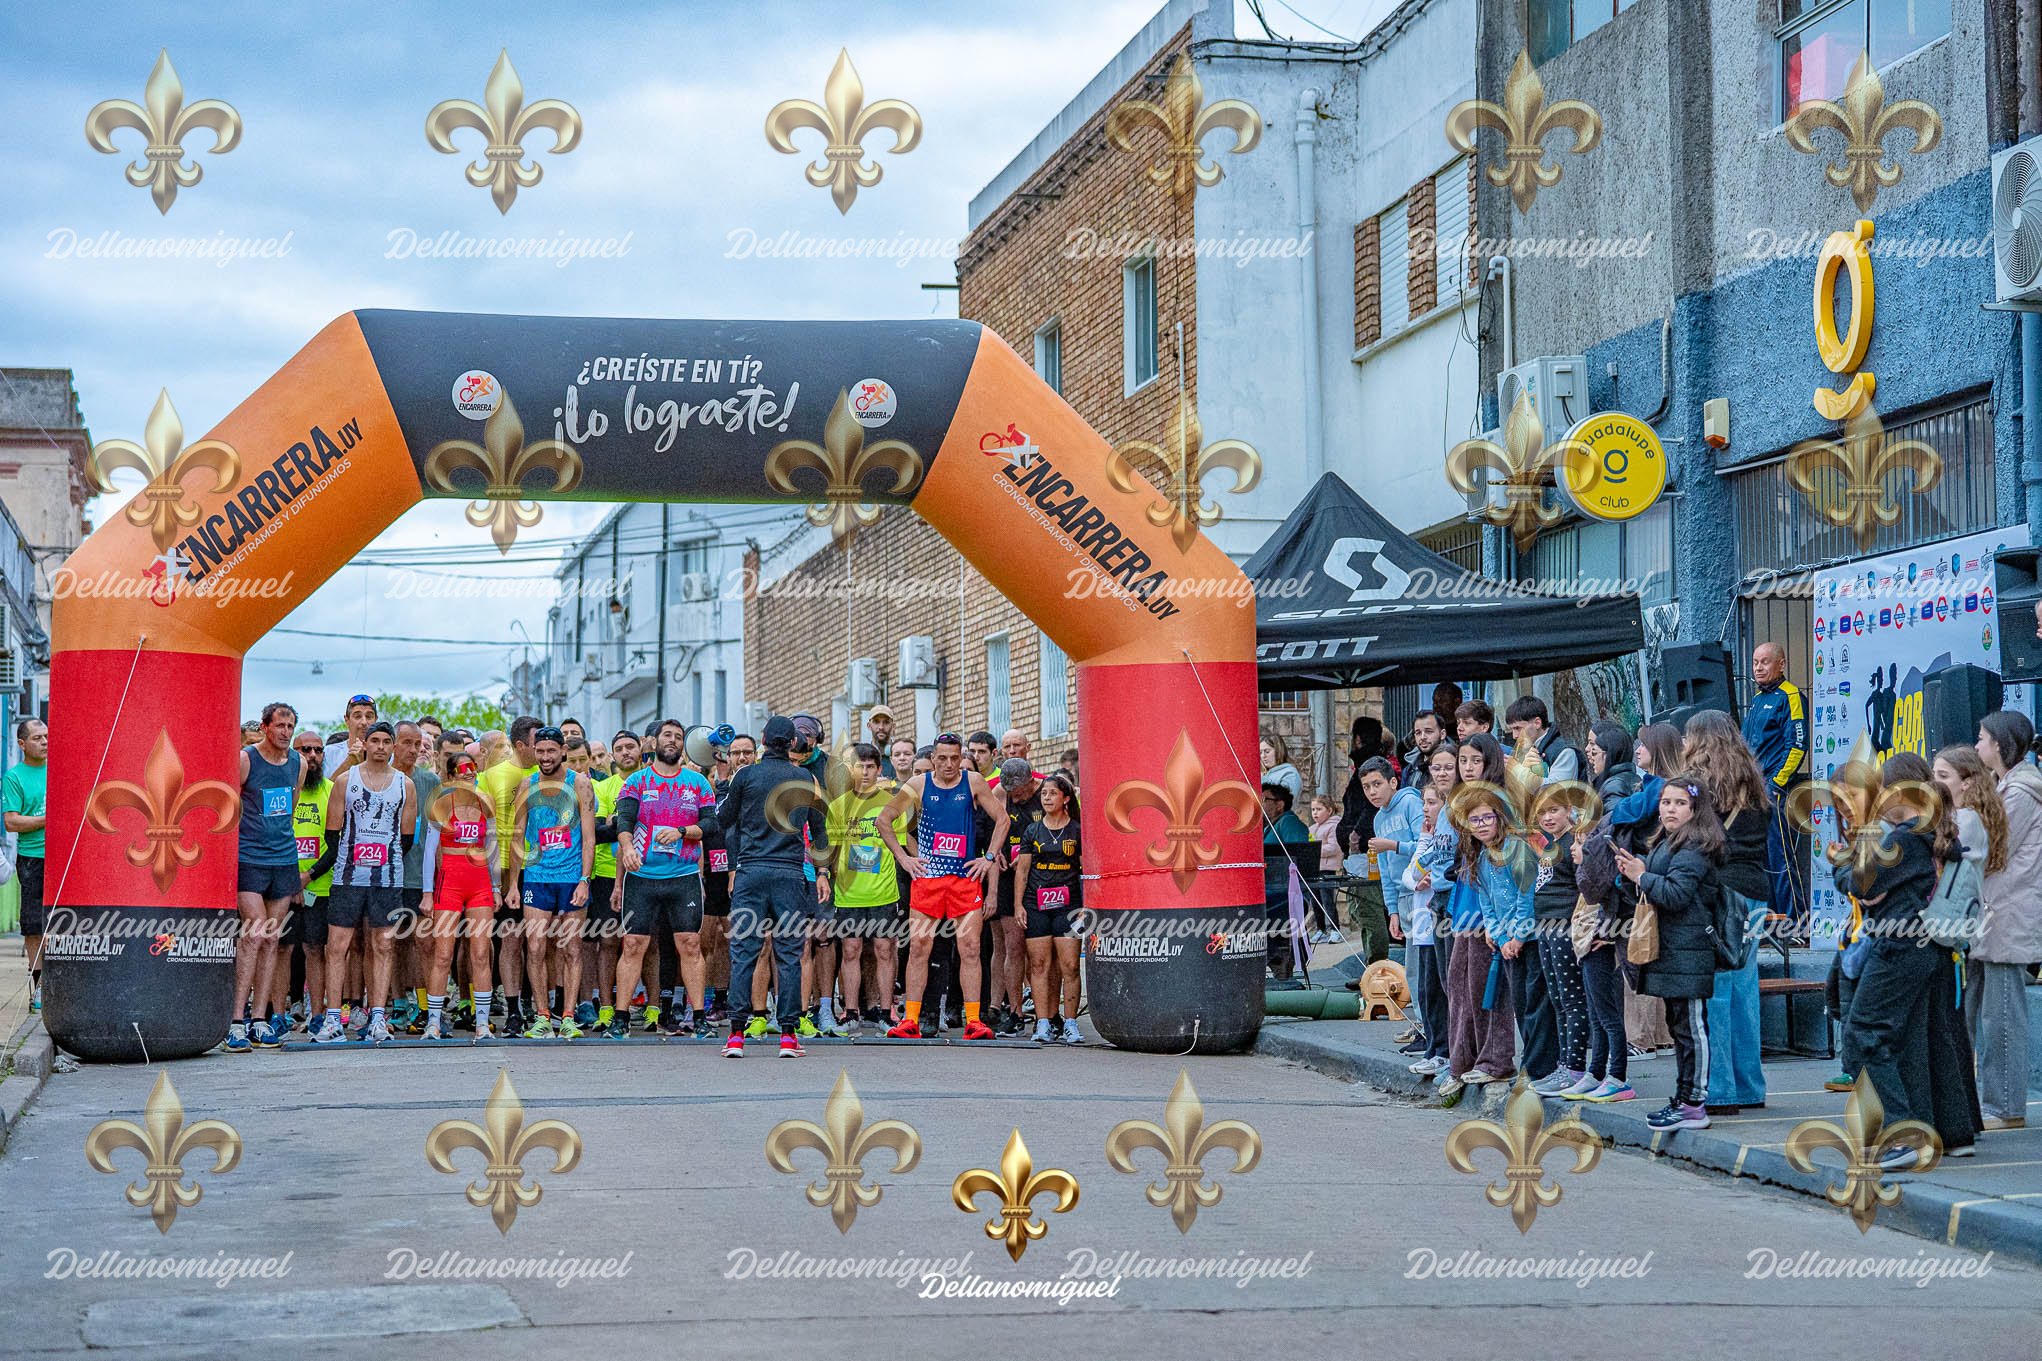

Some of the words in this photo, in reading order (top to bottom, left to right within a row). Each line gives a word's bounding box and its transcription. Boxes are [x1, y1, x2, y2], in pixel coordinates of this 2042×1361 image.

[577, 353, 686, 385] ¿CREÍSTE
[691, 360, 722, 383] EN
[729, 354, 763, 384] TÍ?
[624, 381, 800, 453] lograste!
[1578, 423, 1655, 460] guadalupe
[176, 417, 363, 585] ENCARRERA.UY
[1600, 496, 1630, 508] club
[992, 473, 1076, 552] CRONOMETRAMOS
[1073, 549, 1083, 558] Y
[194, 517, 284, 596] CRONOMETRAMOS
[281, 509, 290, 521] Y
[290, 458, 353, 515] DIFUNDIMOS
[1001, 452, 1181, 621] ENCARRERA.UY
[1267, 602, 1502, 622] SCOTT
[1256, 635, 1379, 663] COTT
[1892, 690, 1926, 749] COR
[270, 795, 287, 809] 413
[460, 824, 479, 838] 178
[544, 831, 563, 844] 179
[296, 839, 316, 853] 245
[358, 846, 382, 859] 234
[938, 836, 961, 851] 207
[852, 854, 876, 866] 406
[1042, 890, 1065, 904] 224
[1095, 937, 1184, 956] ENCARRERA.UY
